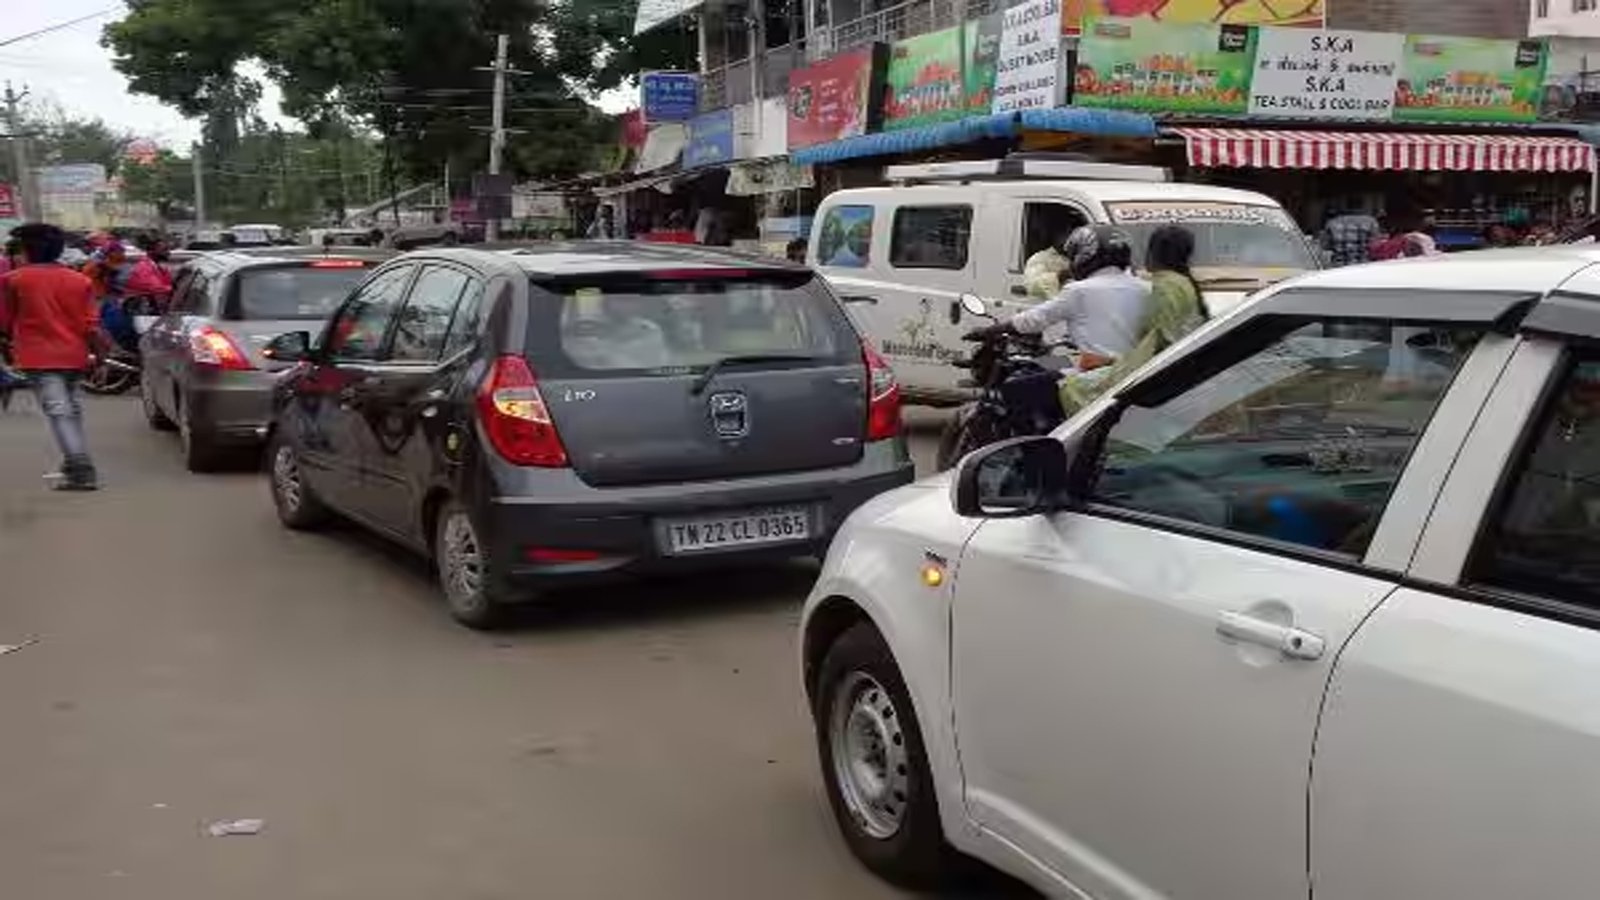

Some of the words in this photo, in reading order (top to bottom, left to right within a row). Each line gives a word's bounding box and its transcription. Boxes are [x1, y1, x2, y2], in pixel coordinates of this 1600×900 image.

[1311, 36, 1354, 53] S.K.A
[1305, 75, 1346, 93] S.K.A
[1254, 95, 1279, 109] TEA
[675, 523, 700, 546] TN
[703, 521, 727, 544] 22
[731, 517, 755, 540] CL
[758, 514, 804, 538] 0365
